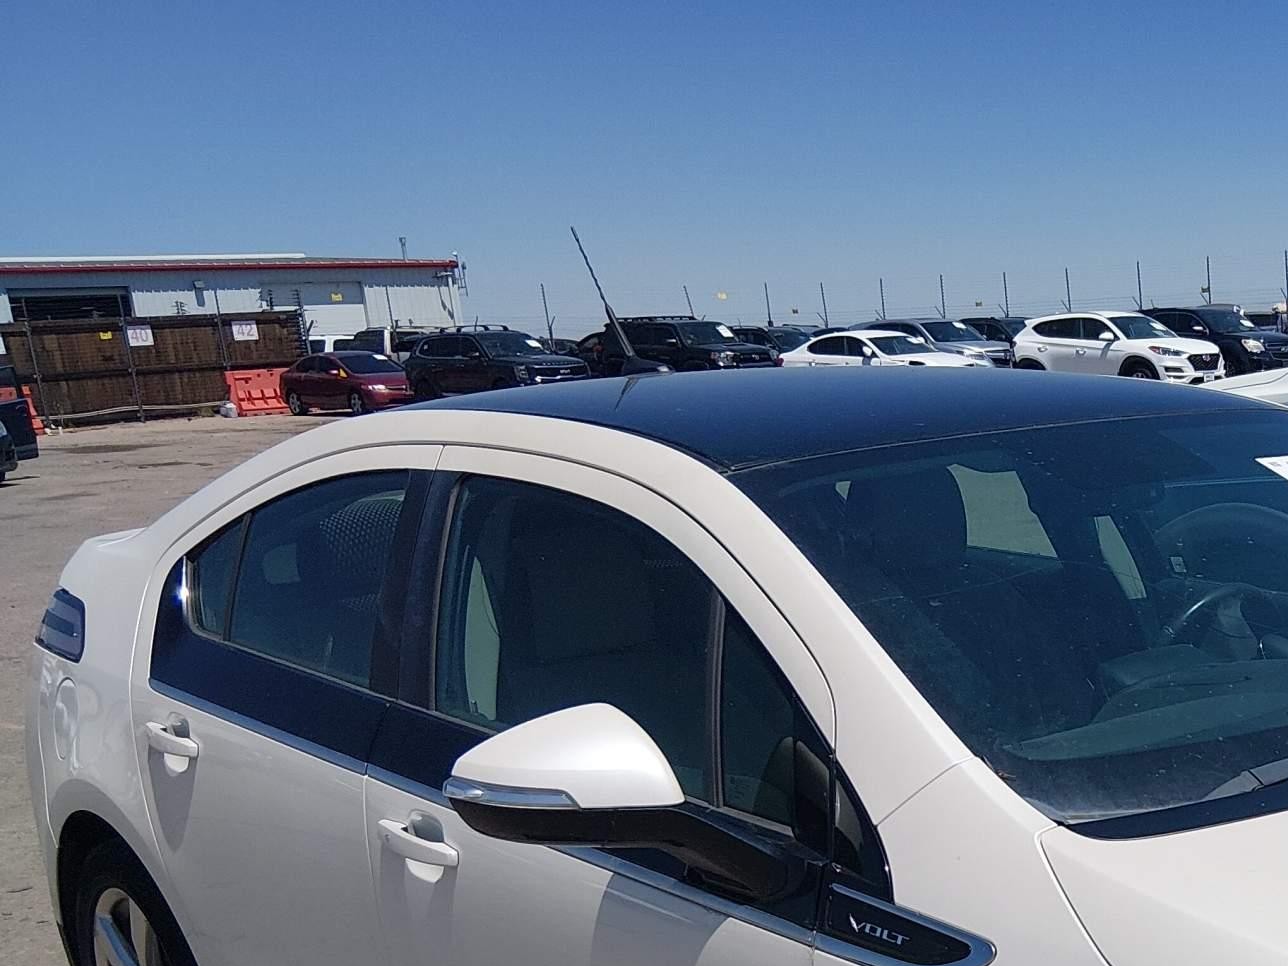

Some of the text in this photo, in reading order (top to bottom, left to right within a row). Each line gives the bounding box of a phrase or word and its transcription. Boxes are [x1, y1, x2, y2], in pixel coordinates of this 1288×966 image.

[130, 329, 149, 343] 40
[237, 324, 256, 337] 42
[848, 913, 910, 946] VOLT
